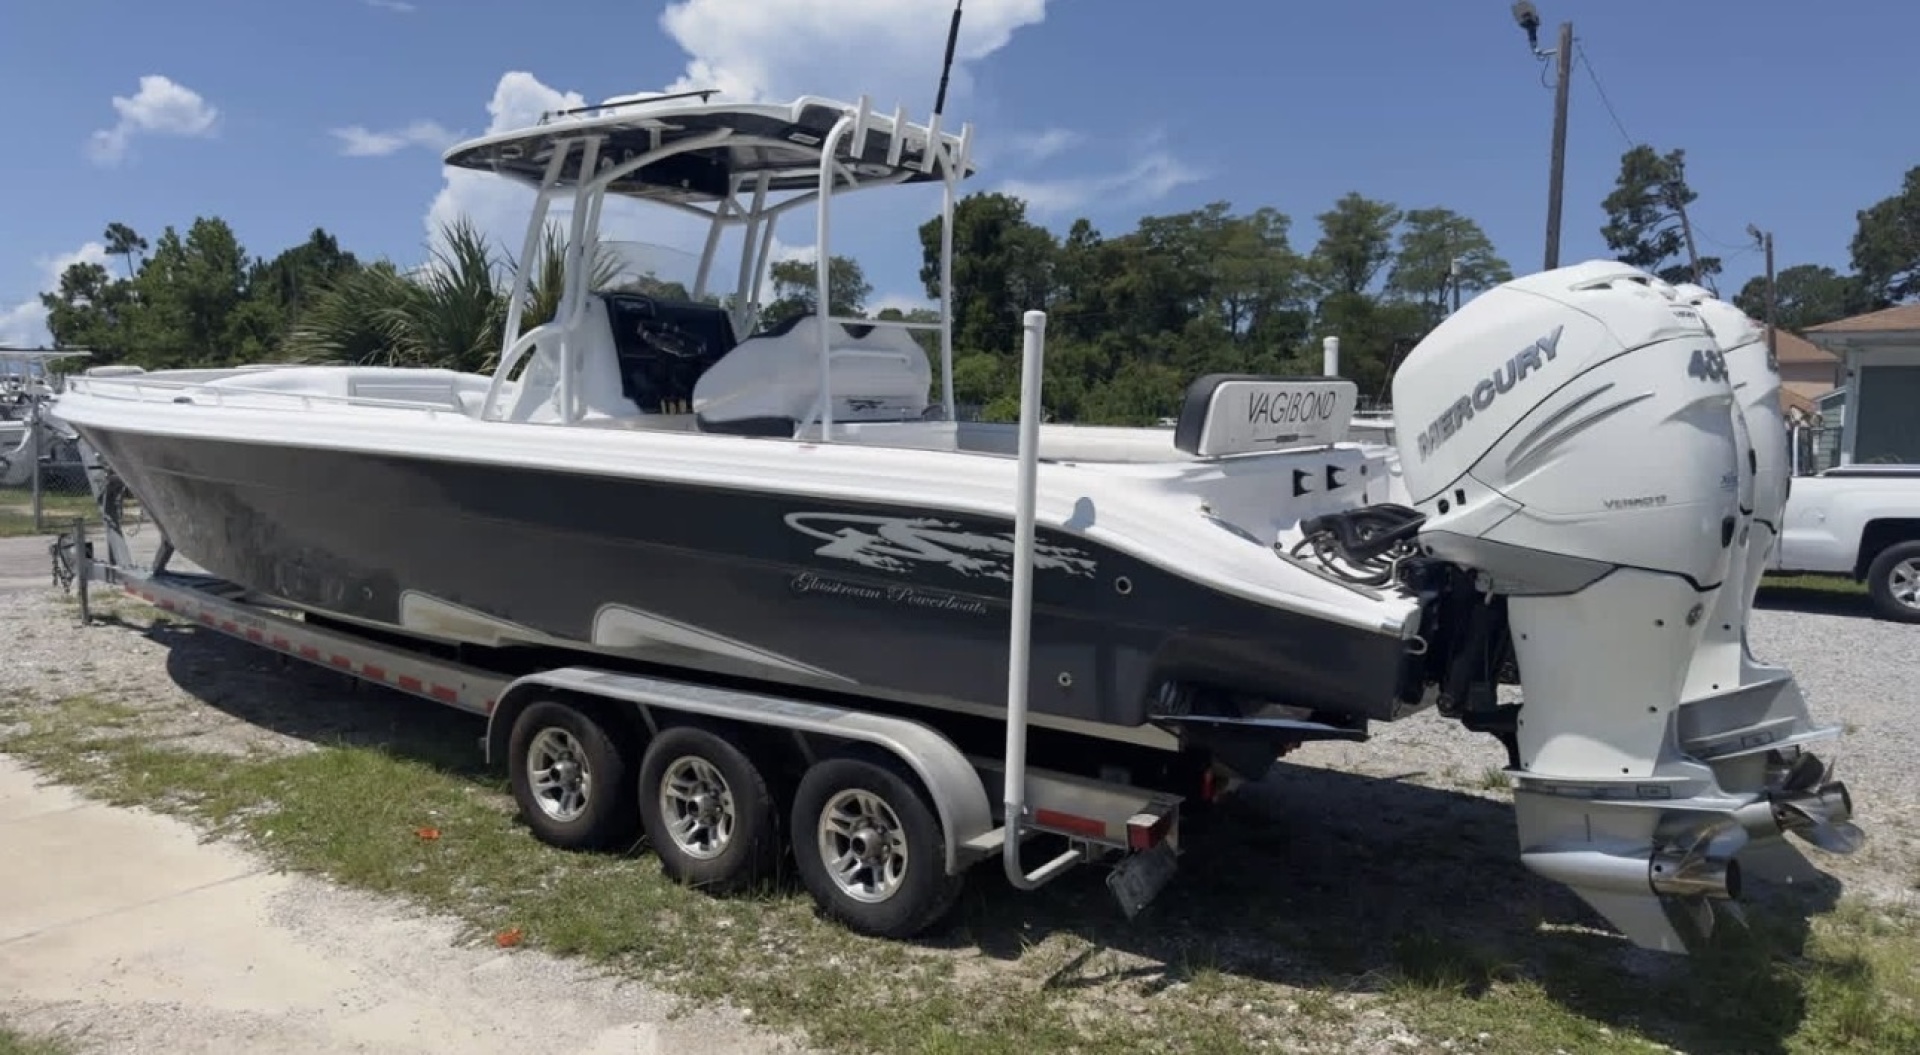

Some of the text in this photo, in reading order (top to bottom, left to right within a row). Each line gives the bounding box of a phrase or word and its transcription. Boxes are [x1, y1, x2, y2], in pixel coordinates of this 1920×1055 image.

[1249, 391, 1336, 424] VAGIBOND
[1417, 324, 1565, 462] MERCURY
[886, 584, 986, 614] Powerboats
